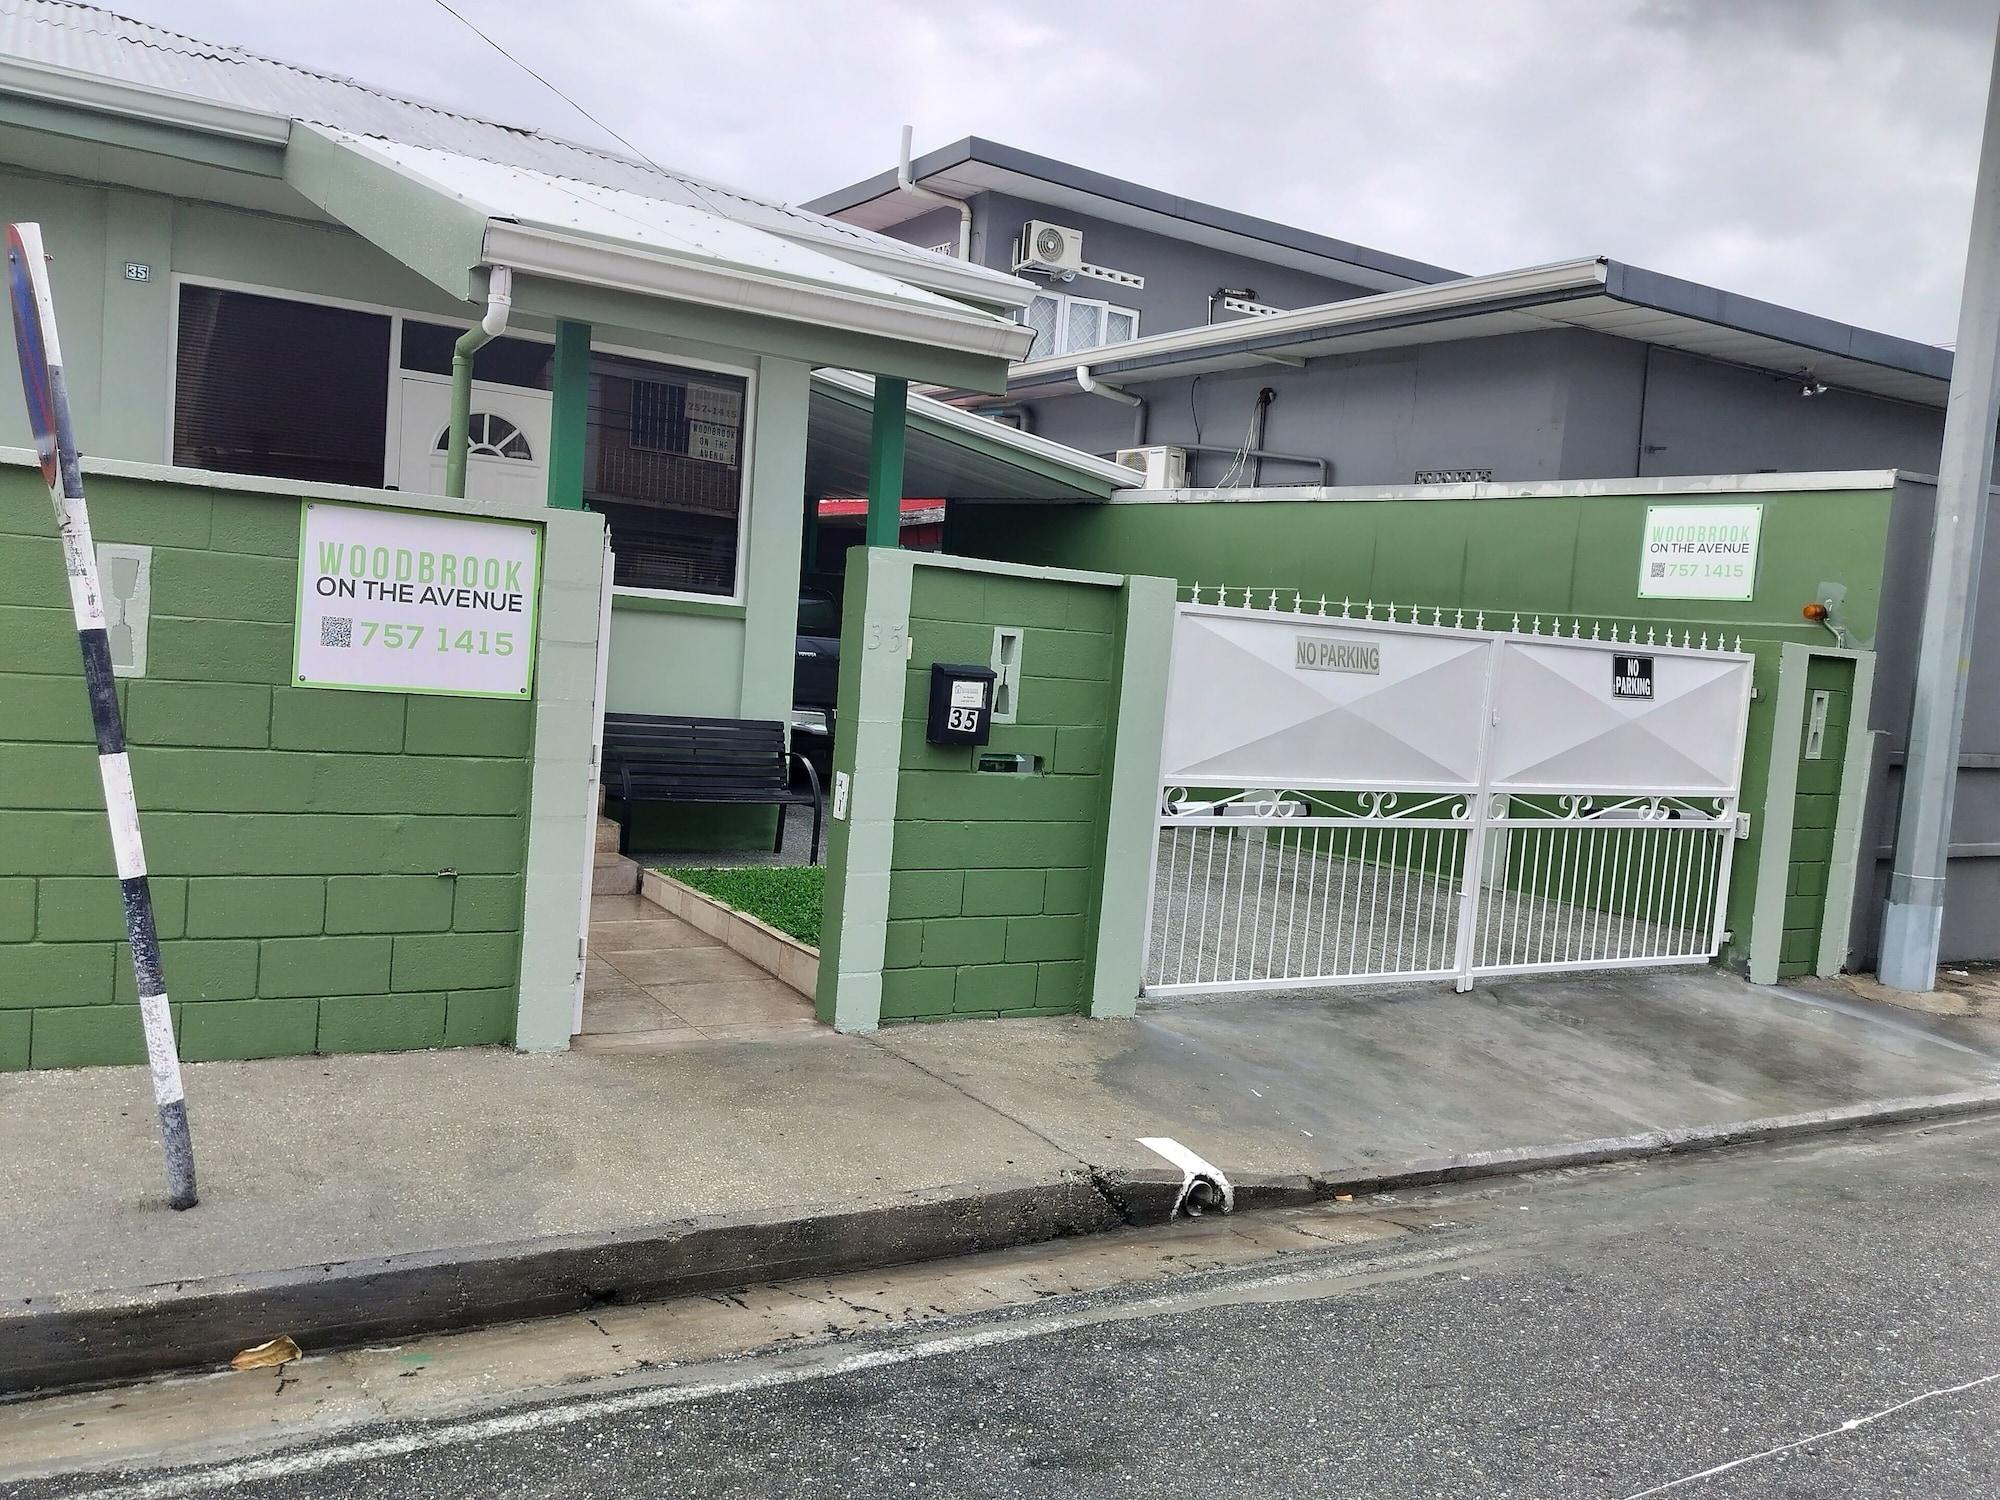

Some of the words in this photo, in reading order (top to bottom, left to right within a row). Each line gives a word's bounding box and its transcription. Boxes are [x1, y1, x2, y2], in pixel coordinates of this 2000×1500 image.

[128, 265, 147, 279] 35
[700, 436, 708, 447] ON
[715, 439, 728, 450] THE
[1652, 525, 1751, 543] WOODBROOK
[1650, 543, 1668, 553] ON
[1671, 543, 1695, 553] THE
[1697, 543, 1750, 553] AVENUE
[318, 541, 523, 593] WOODBROOK
[1668, 563, 1699, 577] 757
[1704, 564, 1744, 578] 1415
[316, 576, 356, 598] ON
[363, 580, 414, 603] THE
[419, 586, 523, 613] AVENUE
[360, 621, 425, 650] 757
[437, 627, 514, 657] 1415
[1297, 641, 1316, 665] NO
[1320, 643, 1379, 670] PARKING
[1627, 658, 1639, 677] NO
[1615, 676, 1651, 696] PARKING
[950, 709, 976, 730] 35
